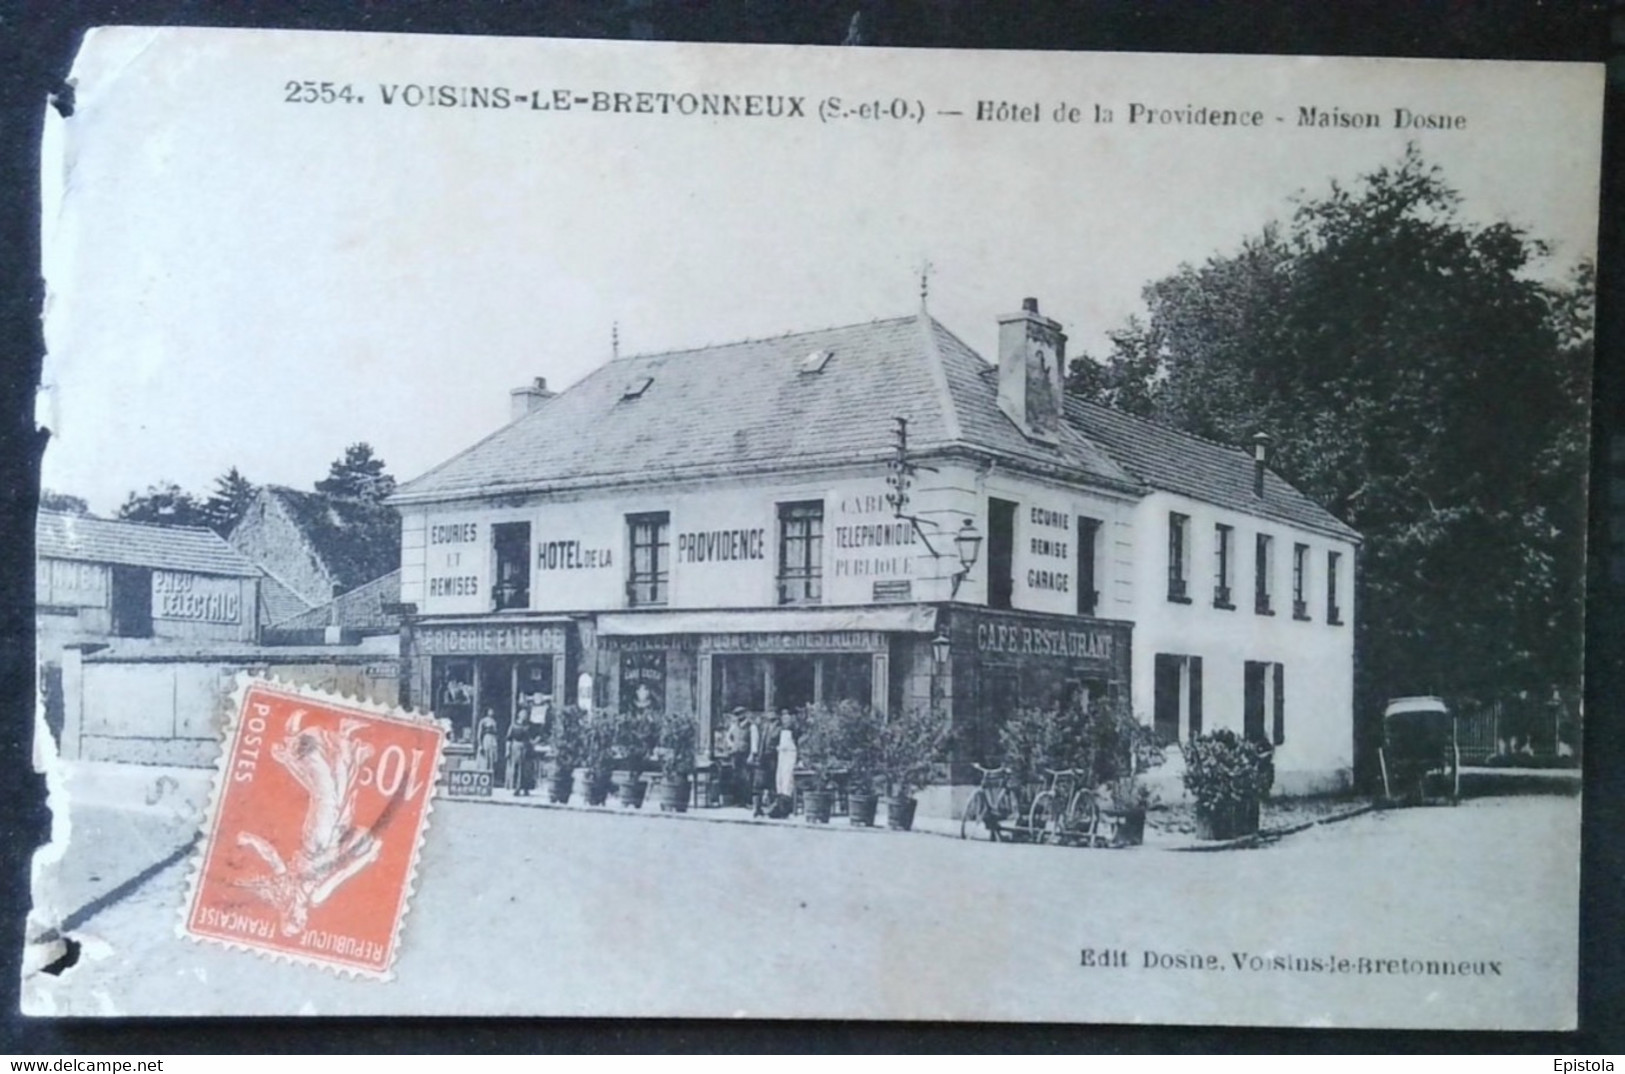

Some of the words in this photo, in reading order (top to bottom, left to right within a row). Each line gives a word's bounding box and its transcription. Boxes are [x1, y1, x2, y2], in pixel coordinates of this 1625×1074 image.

[380, 83, 806, 119] VOISINS-LE-BRETONNEUX
[1052, 102, 1081, 124] de
[1094, 104, 1114, 125] la
[1128, 103, 1264, 127] Providence
[1297, 106, 1382, 129] Maison
[1393, 108, 1468, 131] Dosne
[1031, 507, 1069, 530] ECURIE
[431, 523, 477, 545] ECURIES
[678, 528, 765, 563] PROVIDENCE
[538, 541, 583, 570] HOTEL
[584, 550, 597, 568] DE
[599, 549, 613, 568] LA
[1031, 538, 1068, 559] REMISE
[155, 573, 193, 594] PNEU
[430, 577, 478, 597] REMISES
[1027, 569, 1069, 593] GARAGE
[1022, 627, 1112, 659] RESTAURANT
[234, 702, 271, 783] POSTES
[451, 772, 490, 786] MOTO
